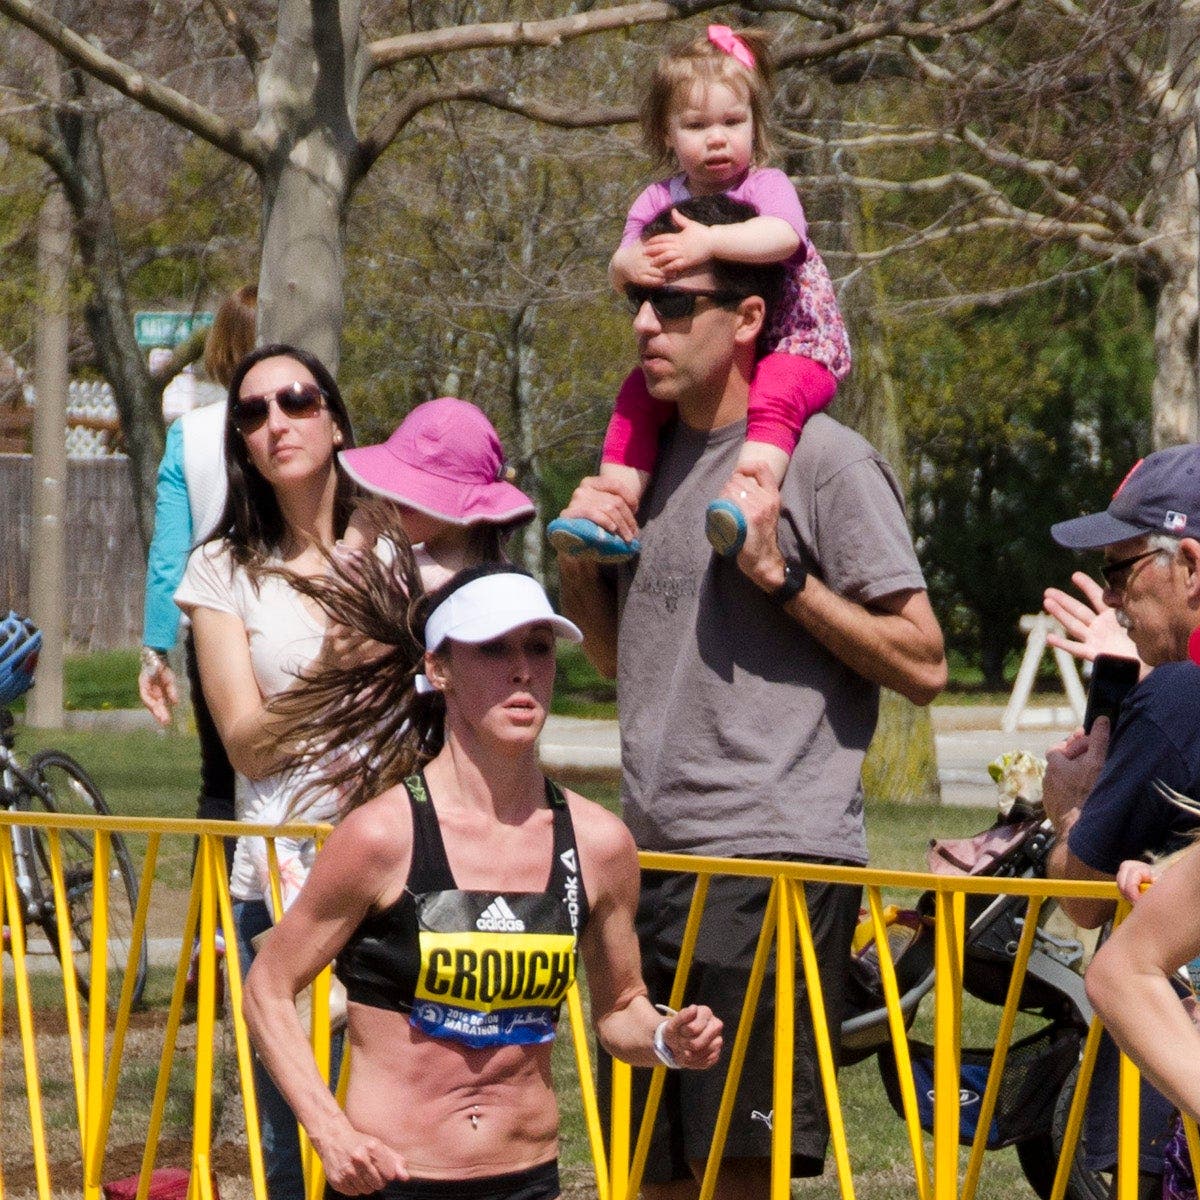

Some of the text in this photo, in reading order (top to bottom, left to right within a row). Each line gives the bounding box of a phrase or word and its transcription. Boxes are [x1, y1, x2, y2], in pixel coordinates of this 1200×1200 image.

[475, 917, 526, 932] adidas
[424, 947, 570, 1004] CROUCH
[446, 1008, 469, 1021] 2016
[444, 1017, 499, 1036] MARATHON
